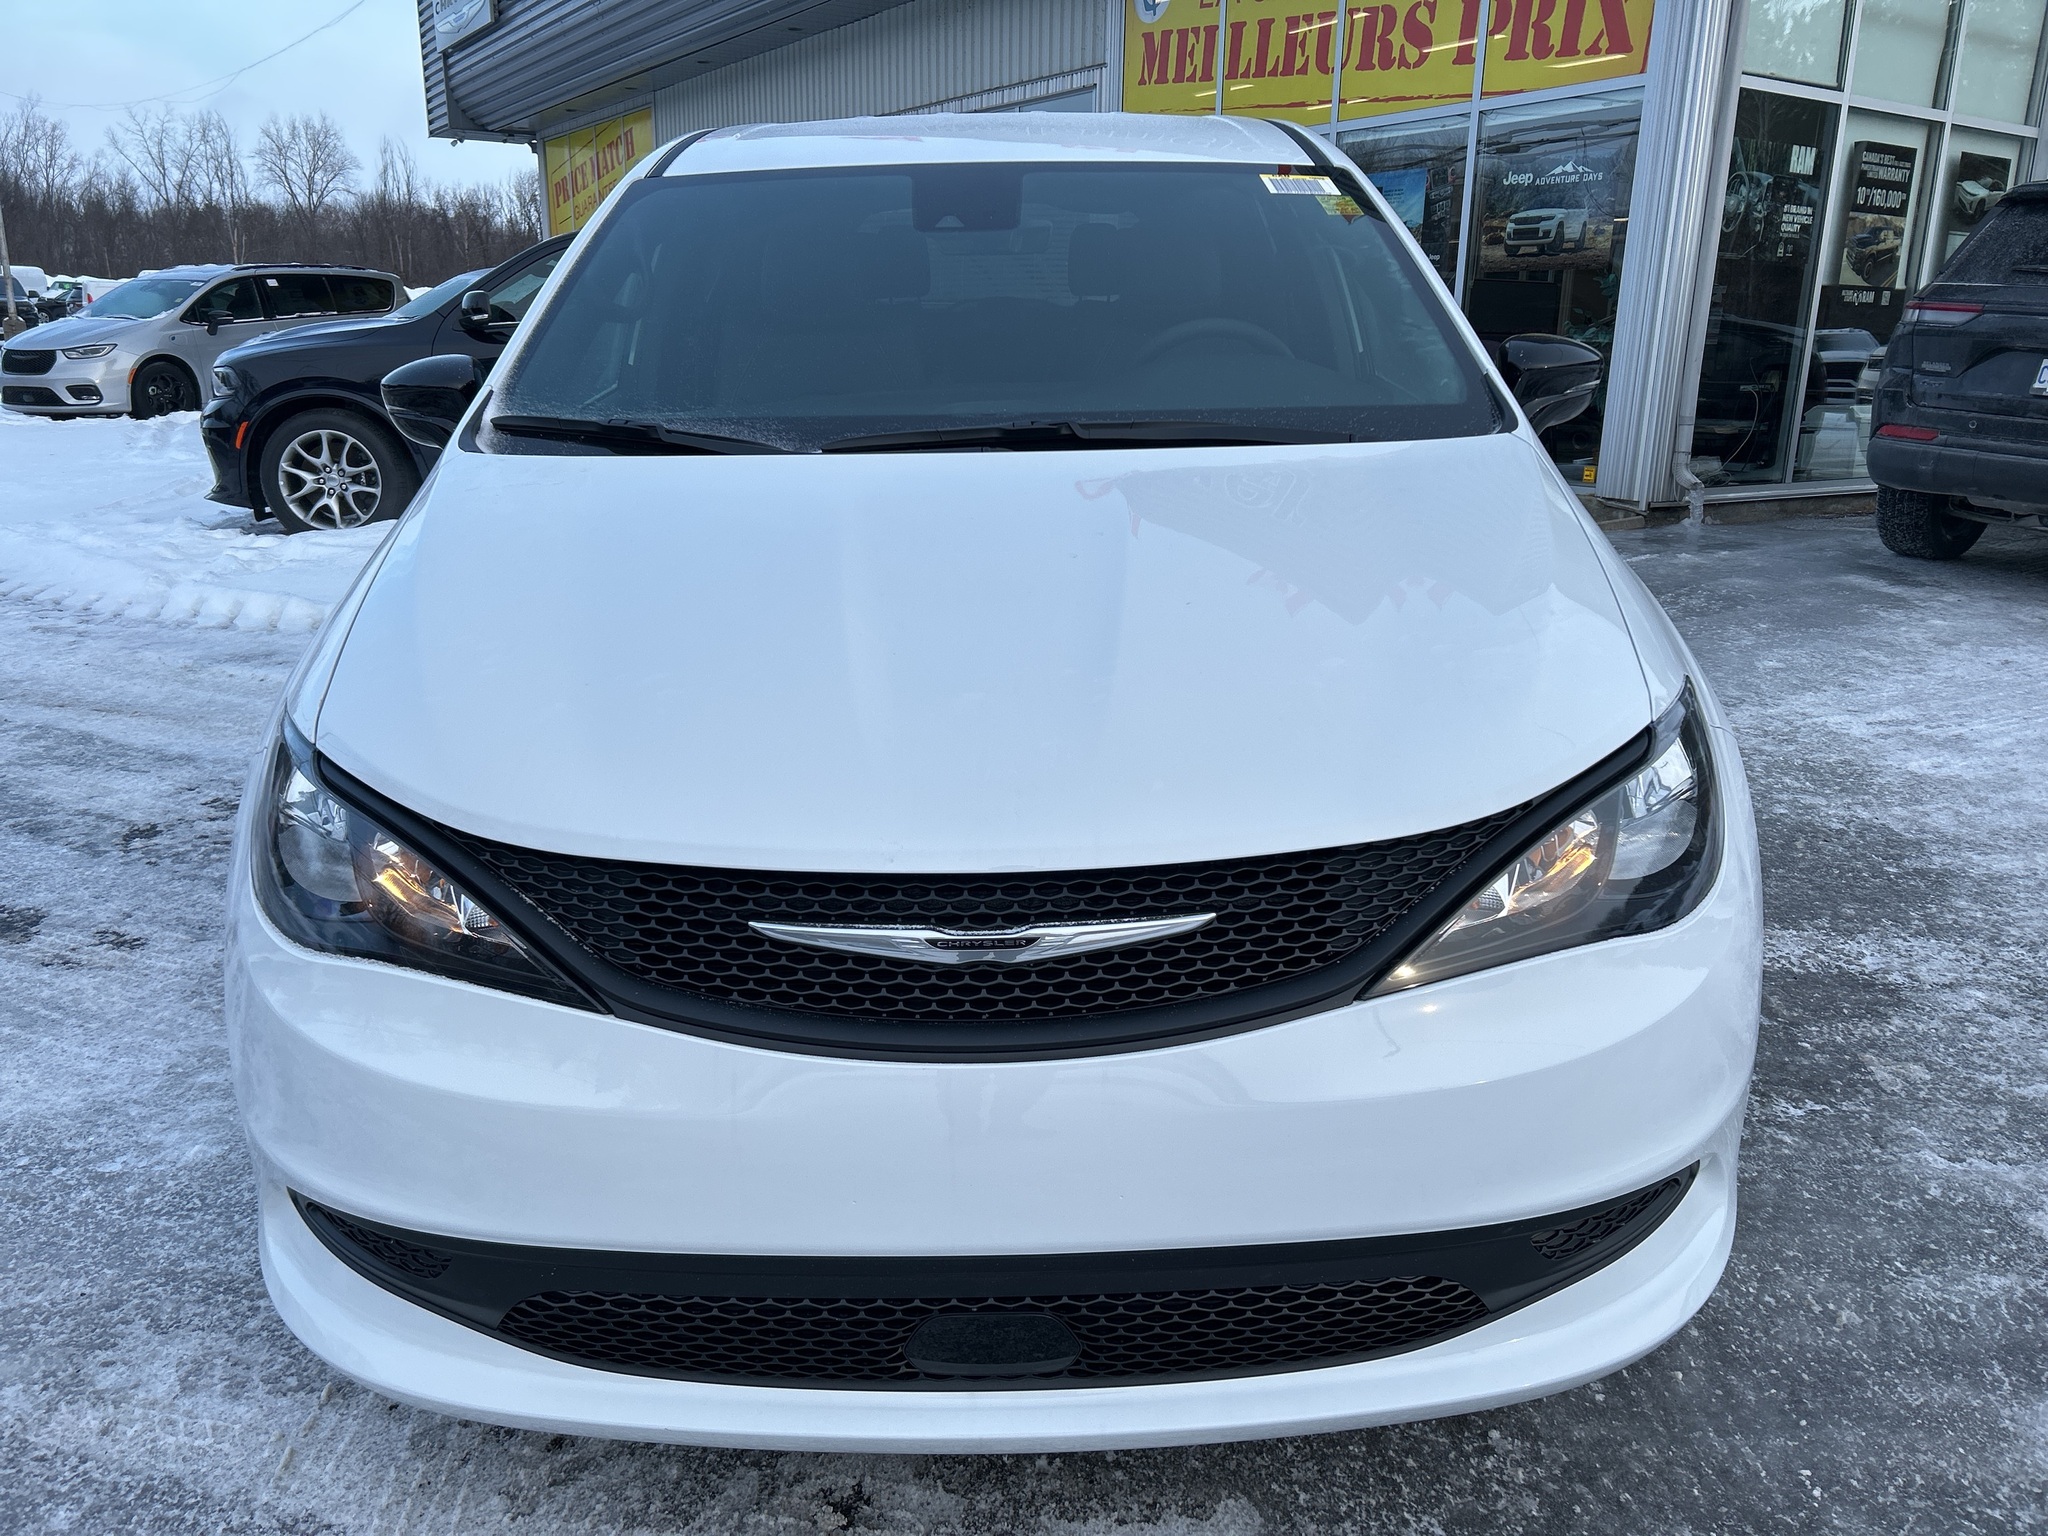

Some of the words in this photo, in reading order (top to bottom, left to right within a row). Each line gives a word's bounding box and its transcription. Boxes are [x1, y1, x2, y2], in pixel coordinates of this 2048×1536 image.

[1138, 0, 1434, 86] MEILLEURS
[1452, 0, 1634, 65] PRIX
[1790, 144, 1817, 175] RAM
[554, 161, 589, 209] PRICE
[1503, 171, 1534, 186] Jeep
[1535, 174, 1580, 186] ADVENTURE
[1583, 172, 1604, 182] DAYS
[1878, 166, 1911, 183] WARRANTY
[1780, 222, 1802, 233] QUALITY
